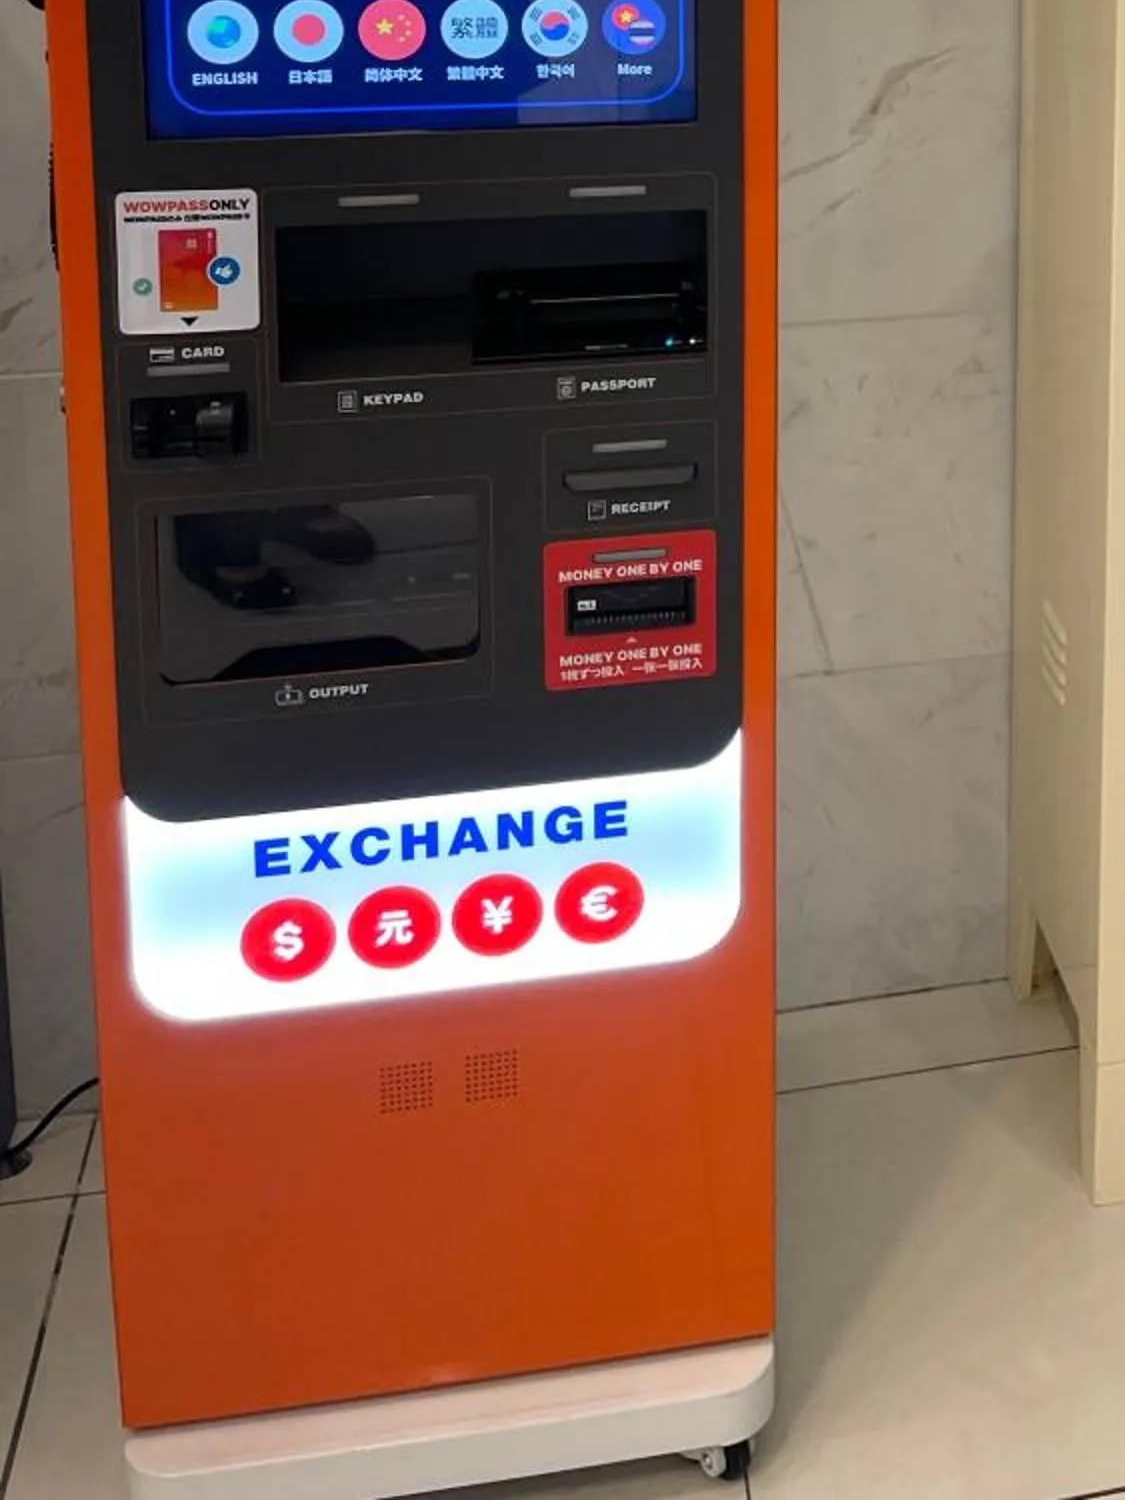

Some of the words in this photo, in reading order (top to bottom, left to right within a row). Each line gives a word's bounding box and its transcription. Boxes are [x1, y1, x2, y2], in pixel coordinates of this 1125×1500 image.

[536, 64, 575, 79] 한국어
[617, 63, 652, 75] More
[192, 71, 258, 86] ENGLISH
[181, 346, 225, 359] CARD
[581, 377, 656, 392] PASSPORT
[363, 392, 423, 407] KEYPAD
[611, 500, 671, 515] RECEIPT
[559, 567, 612, 583] MONEY
[617, 564, 647, 577] ONE
[650, 562, 669, 574] BY
[673, 559, 703, 572] ONE
[560, 651, 614, 667] MONEY
[617, 648, 647, 661] ONE
[649, 646, 669, 658] BY
[673, 643, 703, 656] ONE
[309, 683, 369, 699] OUTPUT
[254, 800, 628, 878] EXCHANGE
